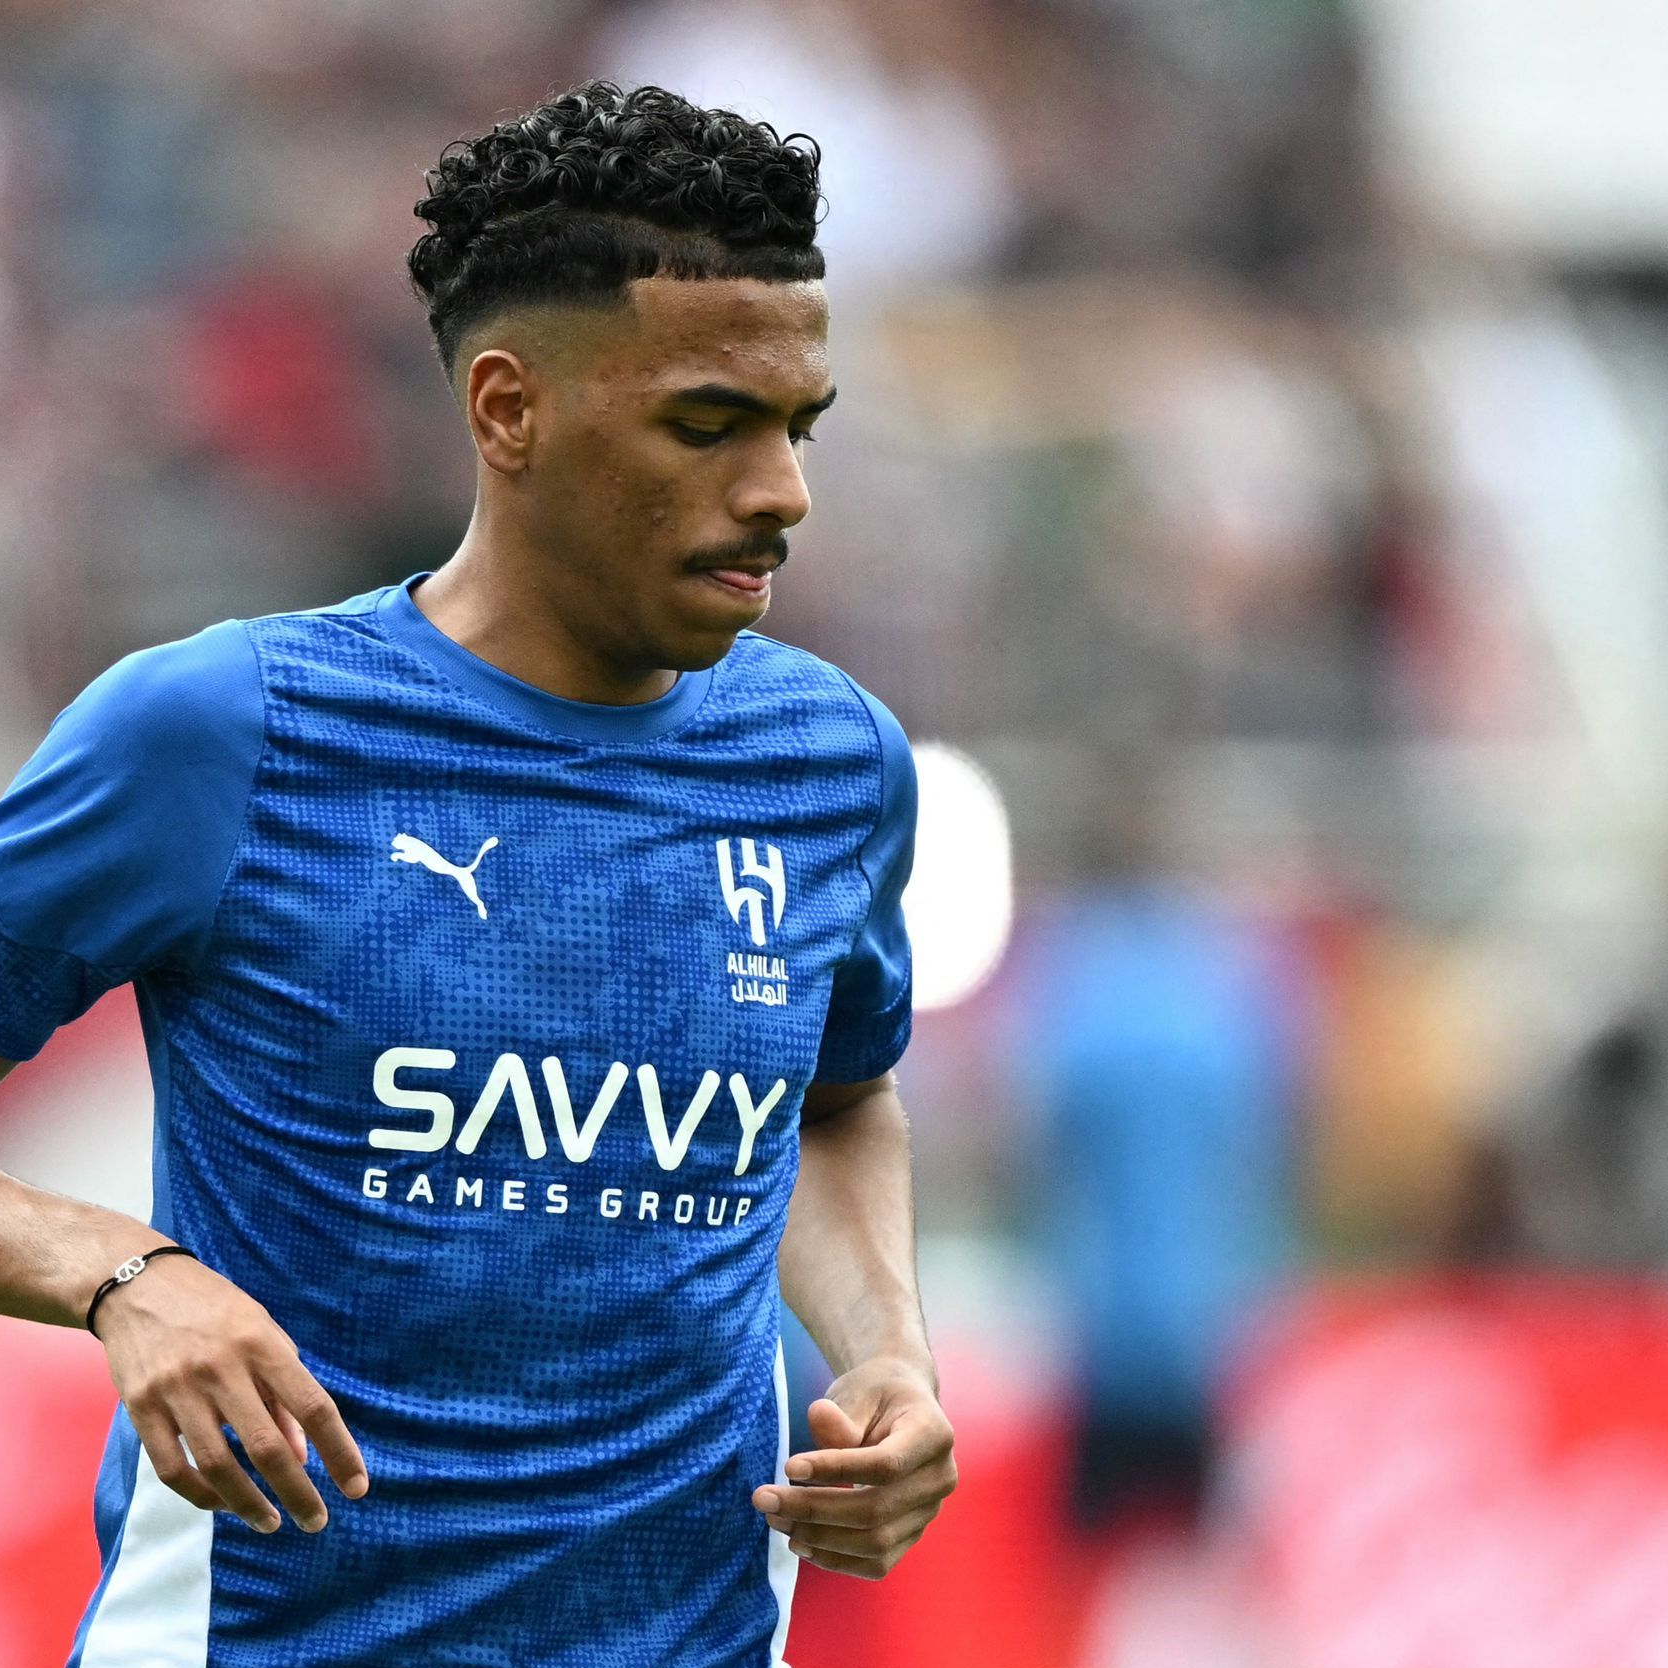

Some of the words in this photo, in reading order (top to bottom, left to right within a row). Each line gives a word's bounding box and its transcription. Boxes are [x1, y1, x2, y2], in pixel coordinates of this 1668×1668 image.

[727, 952, 789, 980] ALHILAL
[732, 978, 787, 1006] الهلال
[368, 1046, 787, 1177] SAVVY
[362, 1168, 568, 1214] GAMES
[600, 1188, 751, 1226] GROUP
